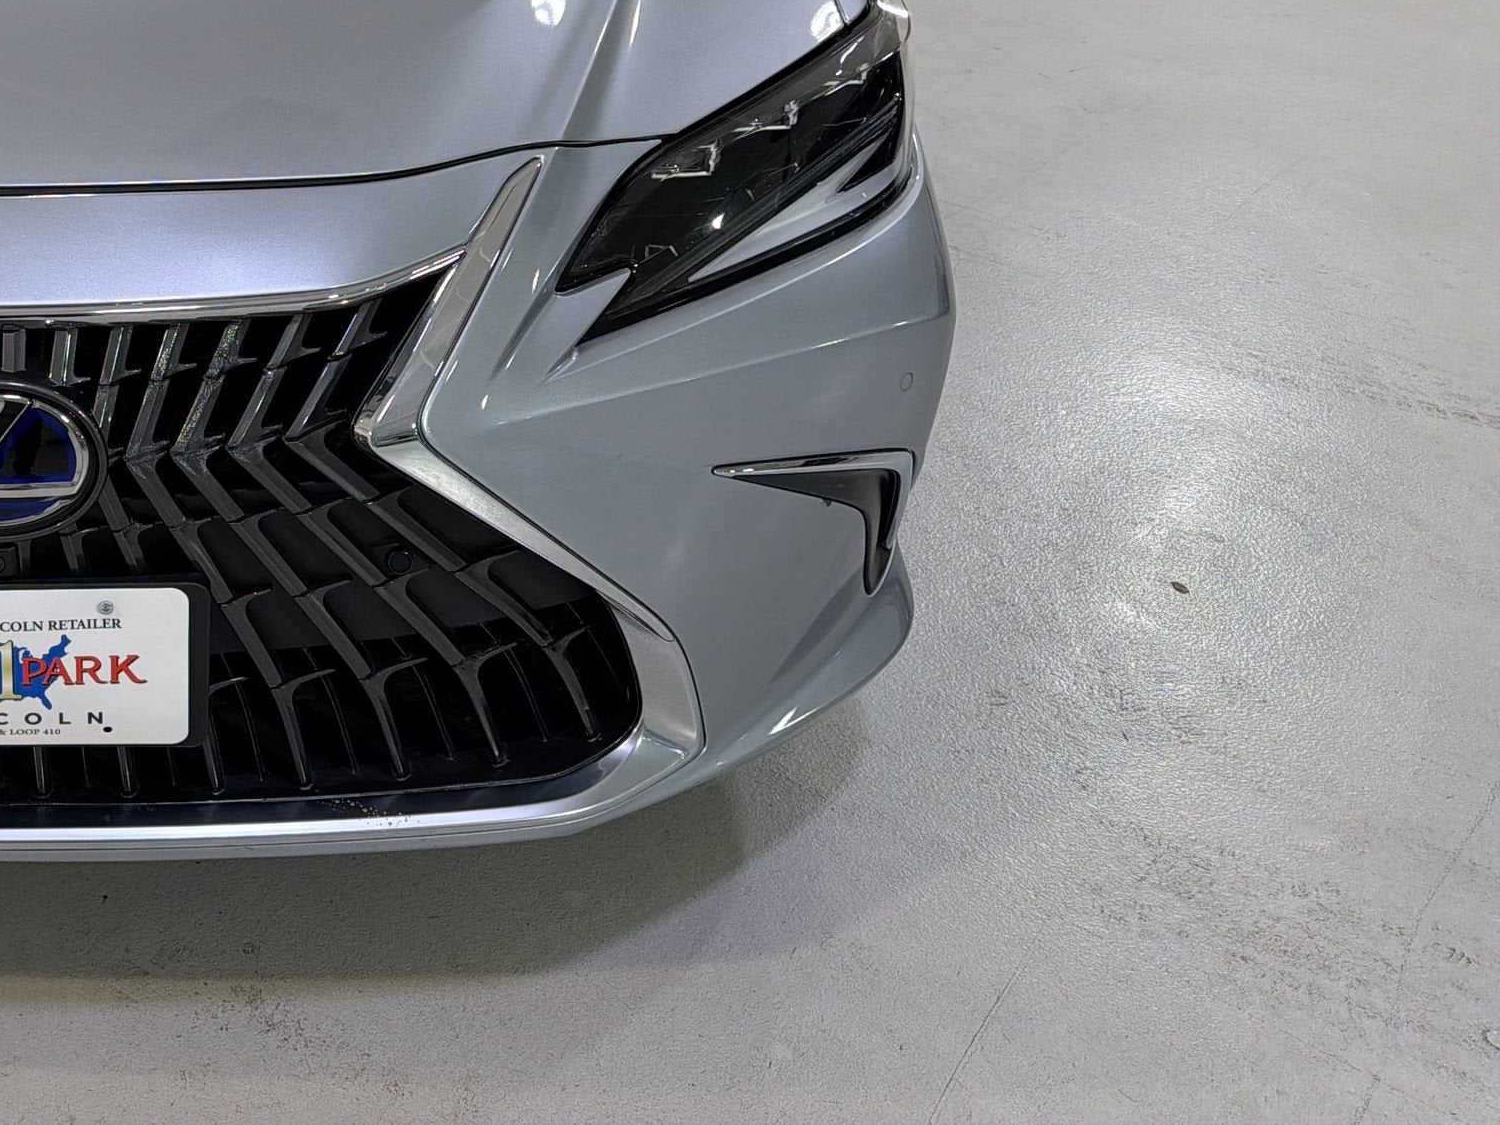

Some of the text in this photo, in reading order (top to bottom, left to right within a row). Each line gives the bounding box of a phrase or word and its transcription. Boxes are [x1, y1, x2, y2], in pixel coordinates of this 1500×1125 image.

[48, 618, 122, 632] RETAILER
[21, 654, 148, 686] PARK
[42, 728, 61, 736] 410
